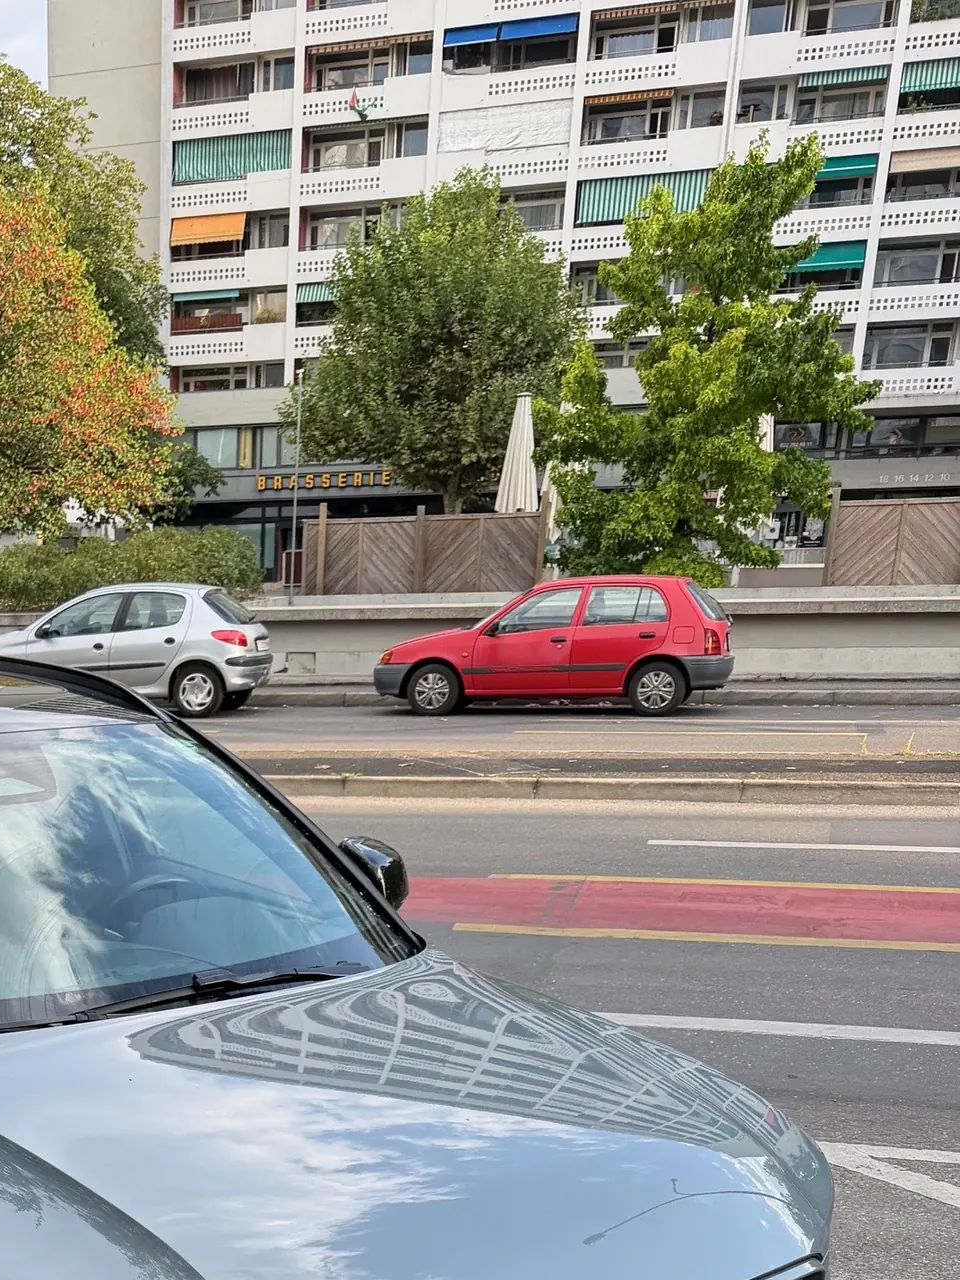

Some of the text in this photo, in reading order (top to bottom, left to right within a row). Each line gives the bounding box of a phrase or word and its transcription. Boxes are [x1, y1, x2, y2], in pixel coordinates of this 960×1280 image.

[257, 471, 391, 490] BRASSERIE
[879, 472, 951, 483] 18 16 14 12 10
